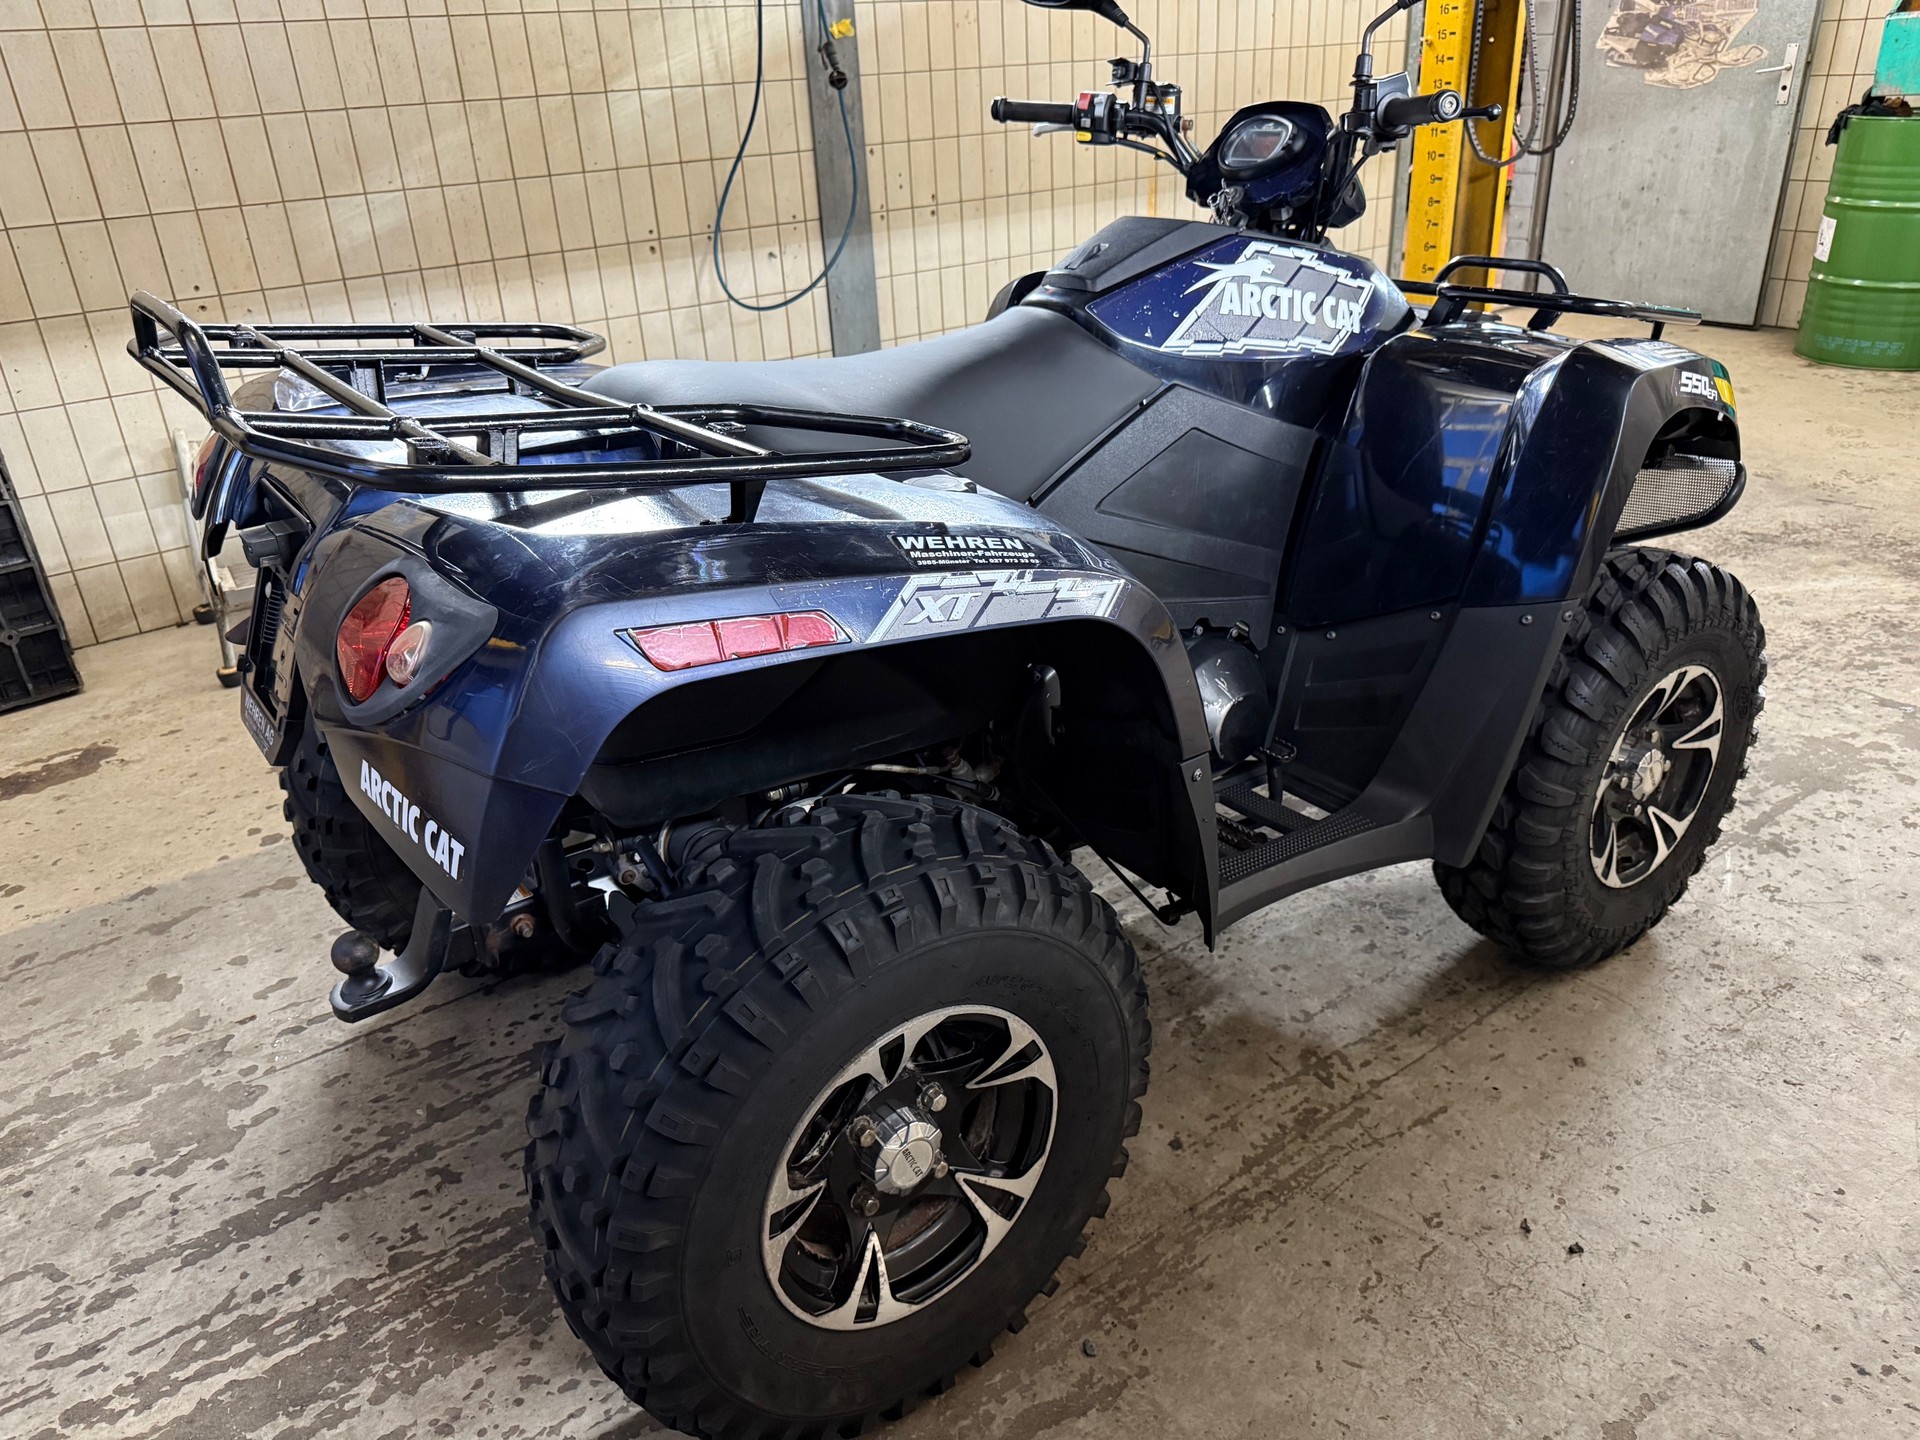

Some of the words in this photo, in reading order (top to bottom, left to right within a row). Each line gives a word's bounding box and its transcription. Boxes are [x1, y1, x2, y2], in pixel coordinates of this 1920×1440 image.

[1440, 4, 1449, 15] 16
[1438, 29, 1447, 40] 15
[1435, 54, 1445, 65] 14
[1433, 79, 1443, 89] 13
[1430, 127, 1438, 138] 11
[1427, 150, 1437, 161] 10
[1430, 174, 1435, 184] 9
[1428, 197, 1433, 207] 8
[1426, 220, 1432, 230] 7
[1424, 242, 1429, 252] 6
[1422, 264, 1427, 274] 5
[1219, 281, 1318, 325] ARCTIC
[1322, 295, 1365, 334] CAT
[1680, 371, 1709, 396] 550
[896, 536, 1024, 550] WEHREN
[910, 550, 1035, 558] Maschinen-Fahrzeuge
[903, 592, 982, 626] XT
[360, 759, 421, 844] ARCTIC
[424, 820, 465, 880] CAT
[902, 1148, 918, 1168] ARCTIC
[912, 1165, 923, 1178] CAT
